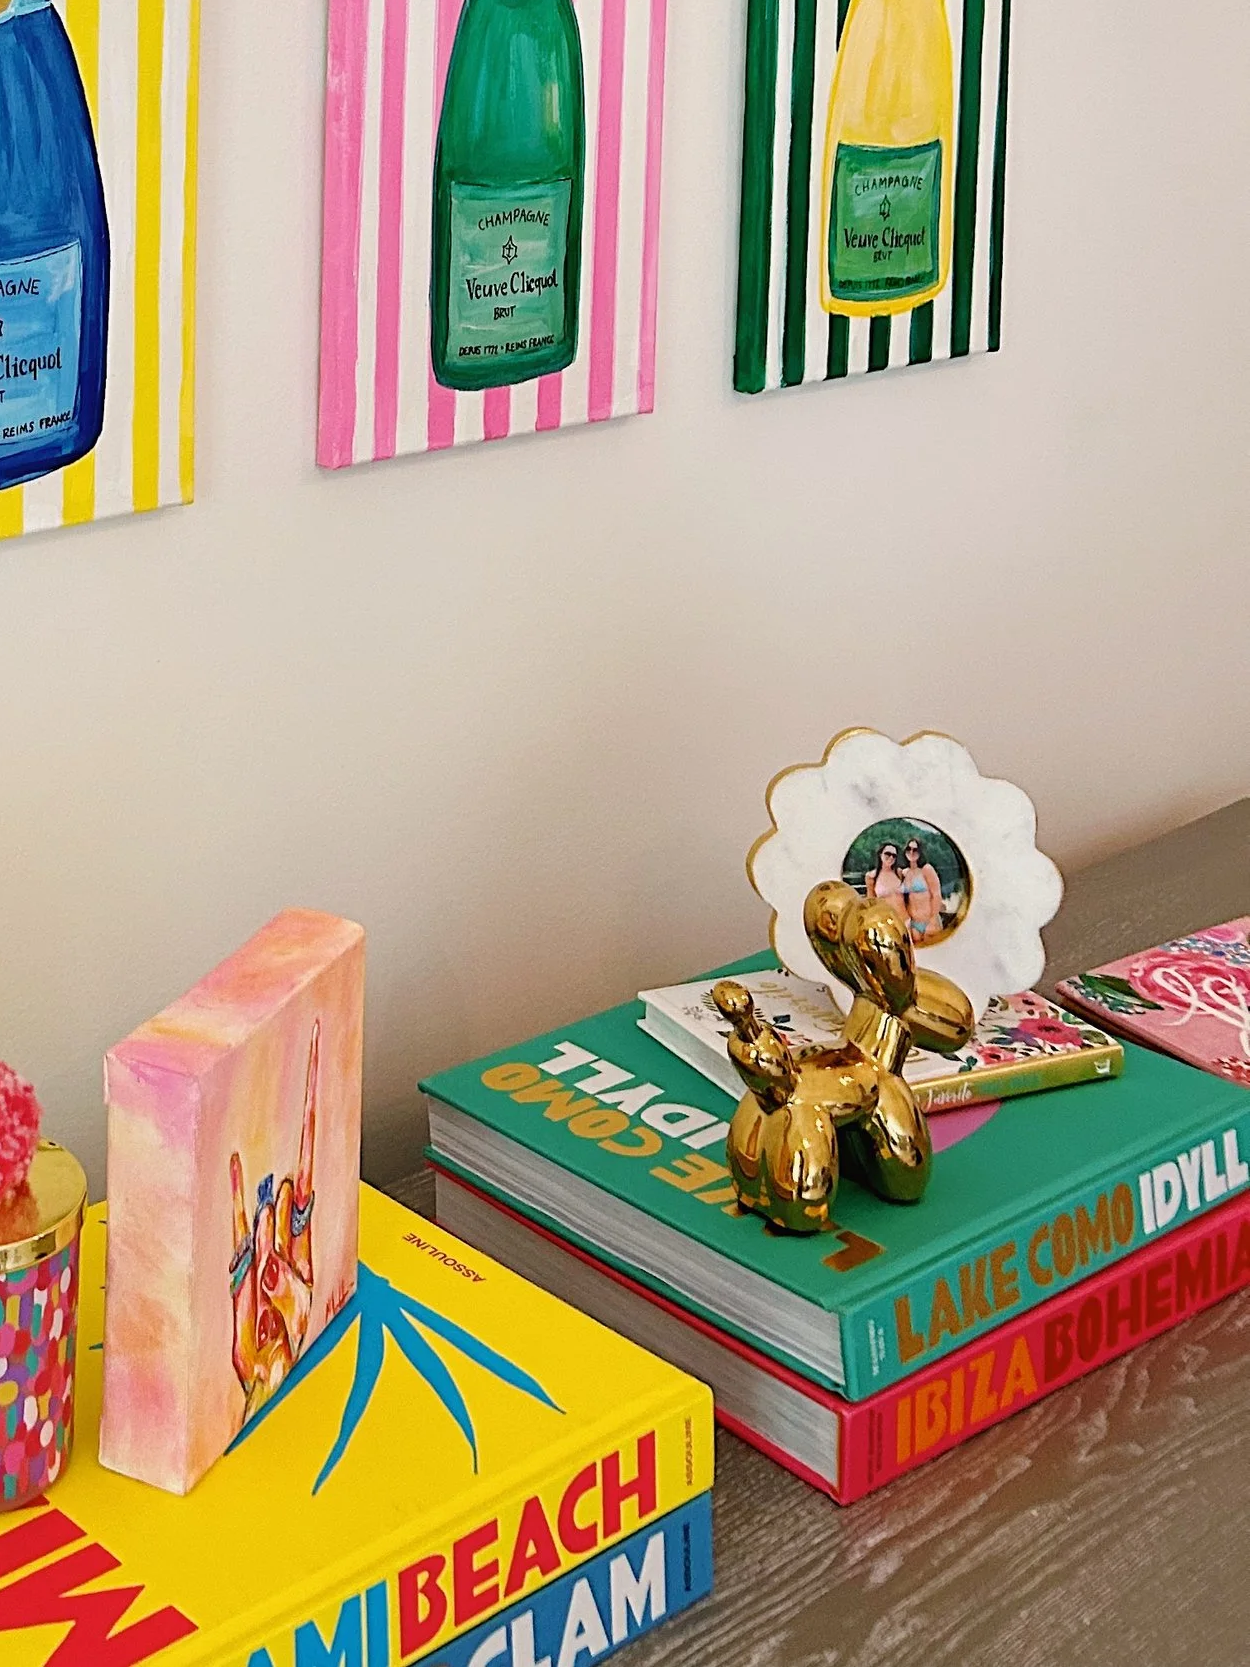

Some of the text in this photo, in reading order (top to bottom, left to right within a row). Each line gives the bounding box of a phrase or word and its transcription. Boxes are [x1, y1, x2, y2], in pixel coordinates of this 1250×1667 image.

[855, 175, 923, 196] CHAMPAGNE
[478, 208, 550, 231] CHAMPAGNE
[844, 228, 878, 248] Veuve
[466, 268, 558, 300] Veuve Clicquot
[494, 305, 516, 320] BRUT
[2, 423, 34, 440] REIMS
[39, 411, 71, 429] FRANCE
[481, 1062, 664, 1157] COMO
[538, 1040, 731, 1150] IDYLL
[402, 1233, 486, 1283] ASSOULINE
[893, 1241, 1021, 1365] LAKE
[1027, 1182, 1135, 1287] COMO
[1139, 1129, 1250, 1235] IDYLL
[896, 1335, 1038, 1465] IBIZA
[398, 1430, 657, 1660] BEACH
